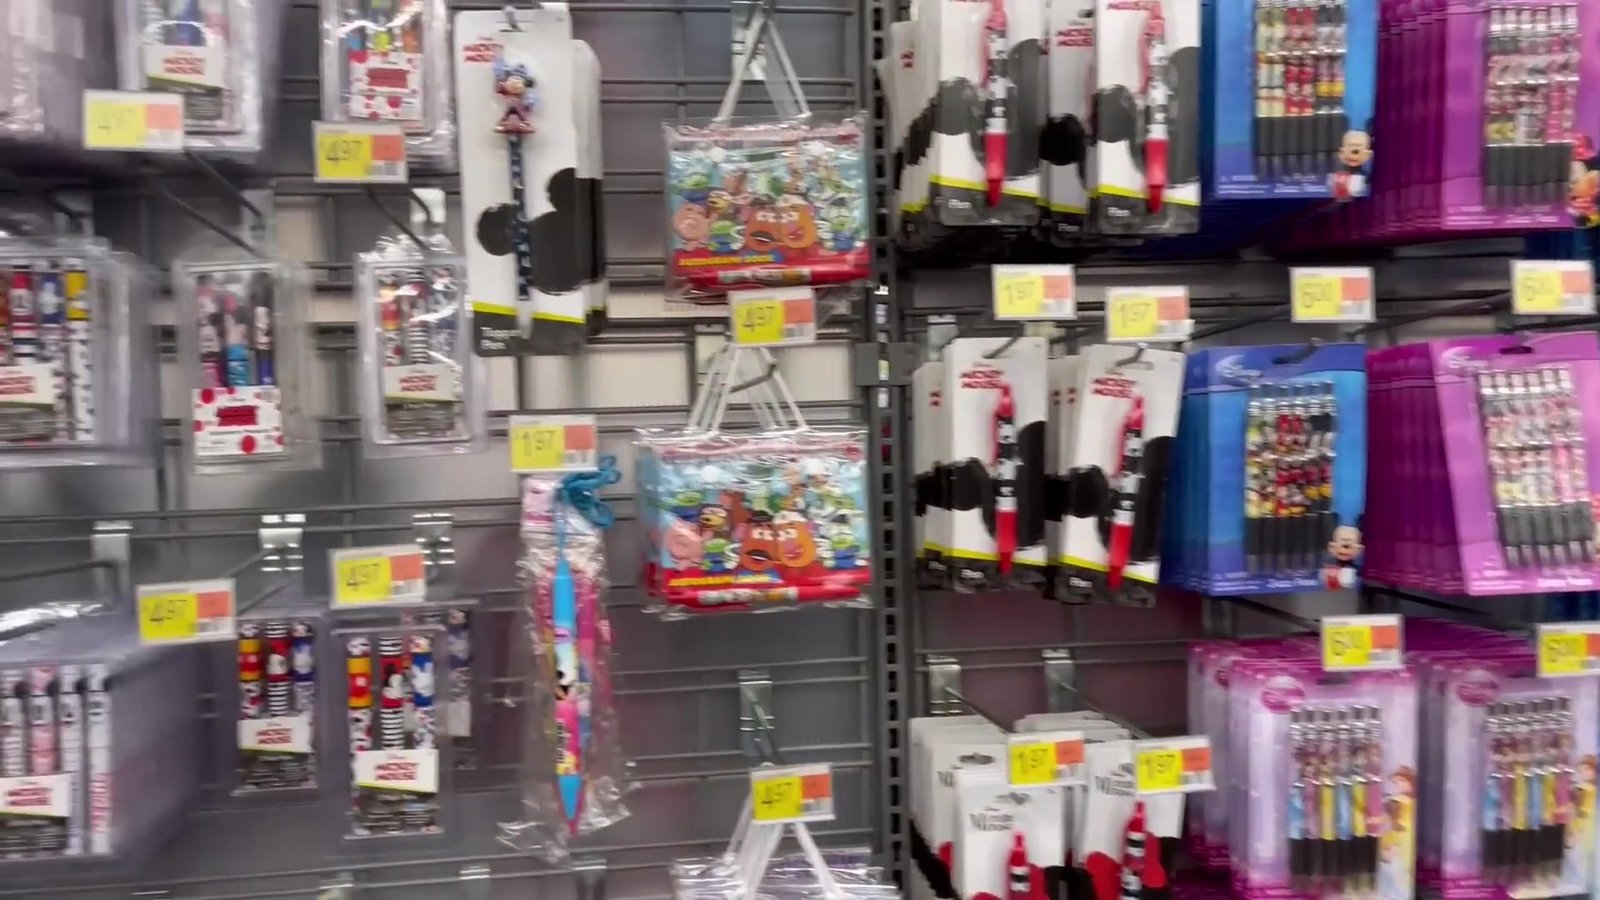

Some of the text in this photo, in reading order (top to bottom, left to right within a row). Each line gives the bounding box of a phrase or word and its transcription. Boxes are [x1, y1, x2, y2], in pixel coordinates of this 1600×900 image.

[326, 140, 363, 166] 497
[1004, 281, 1035, 306] 197
[742, 305, 775, 332] 497
[1119, 302, 1151, 328] 197
[521, 430, 556, 457] 197
[345, 563, 380, 591] 497
[149, 599, 188, 626] 497
[1332, 630, 1363, 656] 600
[1548, 638, 1581, 663] 600
[1018, 748, 1049, 775] 197
[1144, 754, 1175, 780] 197
[761, 781, 793, 809] 497
